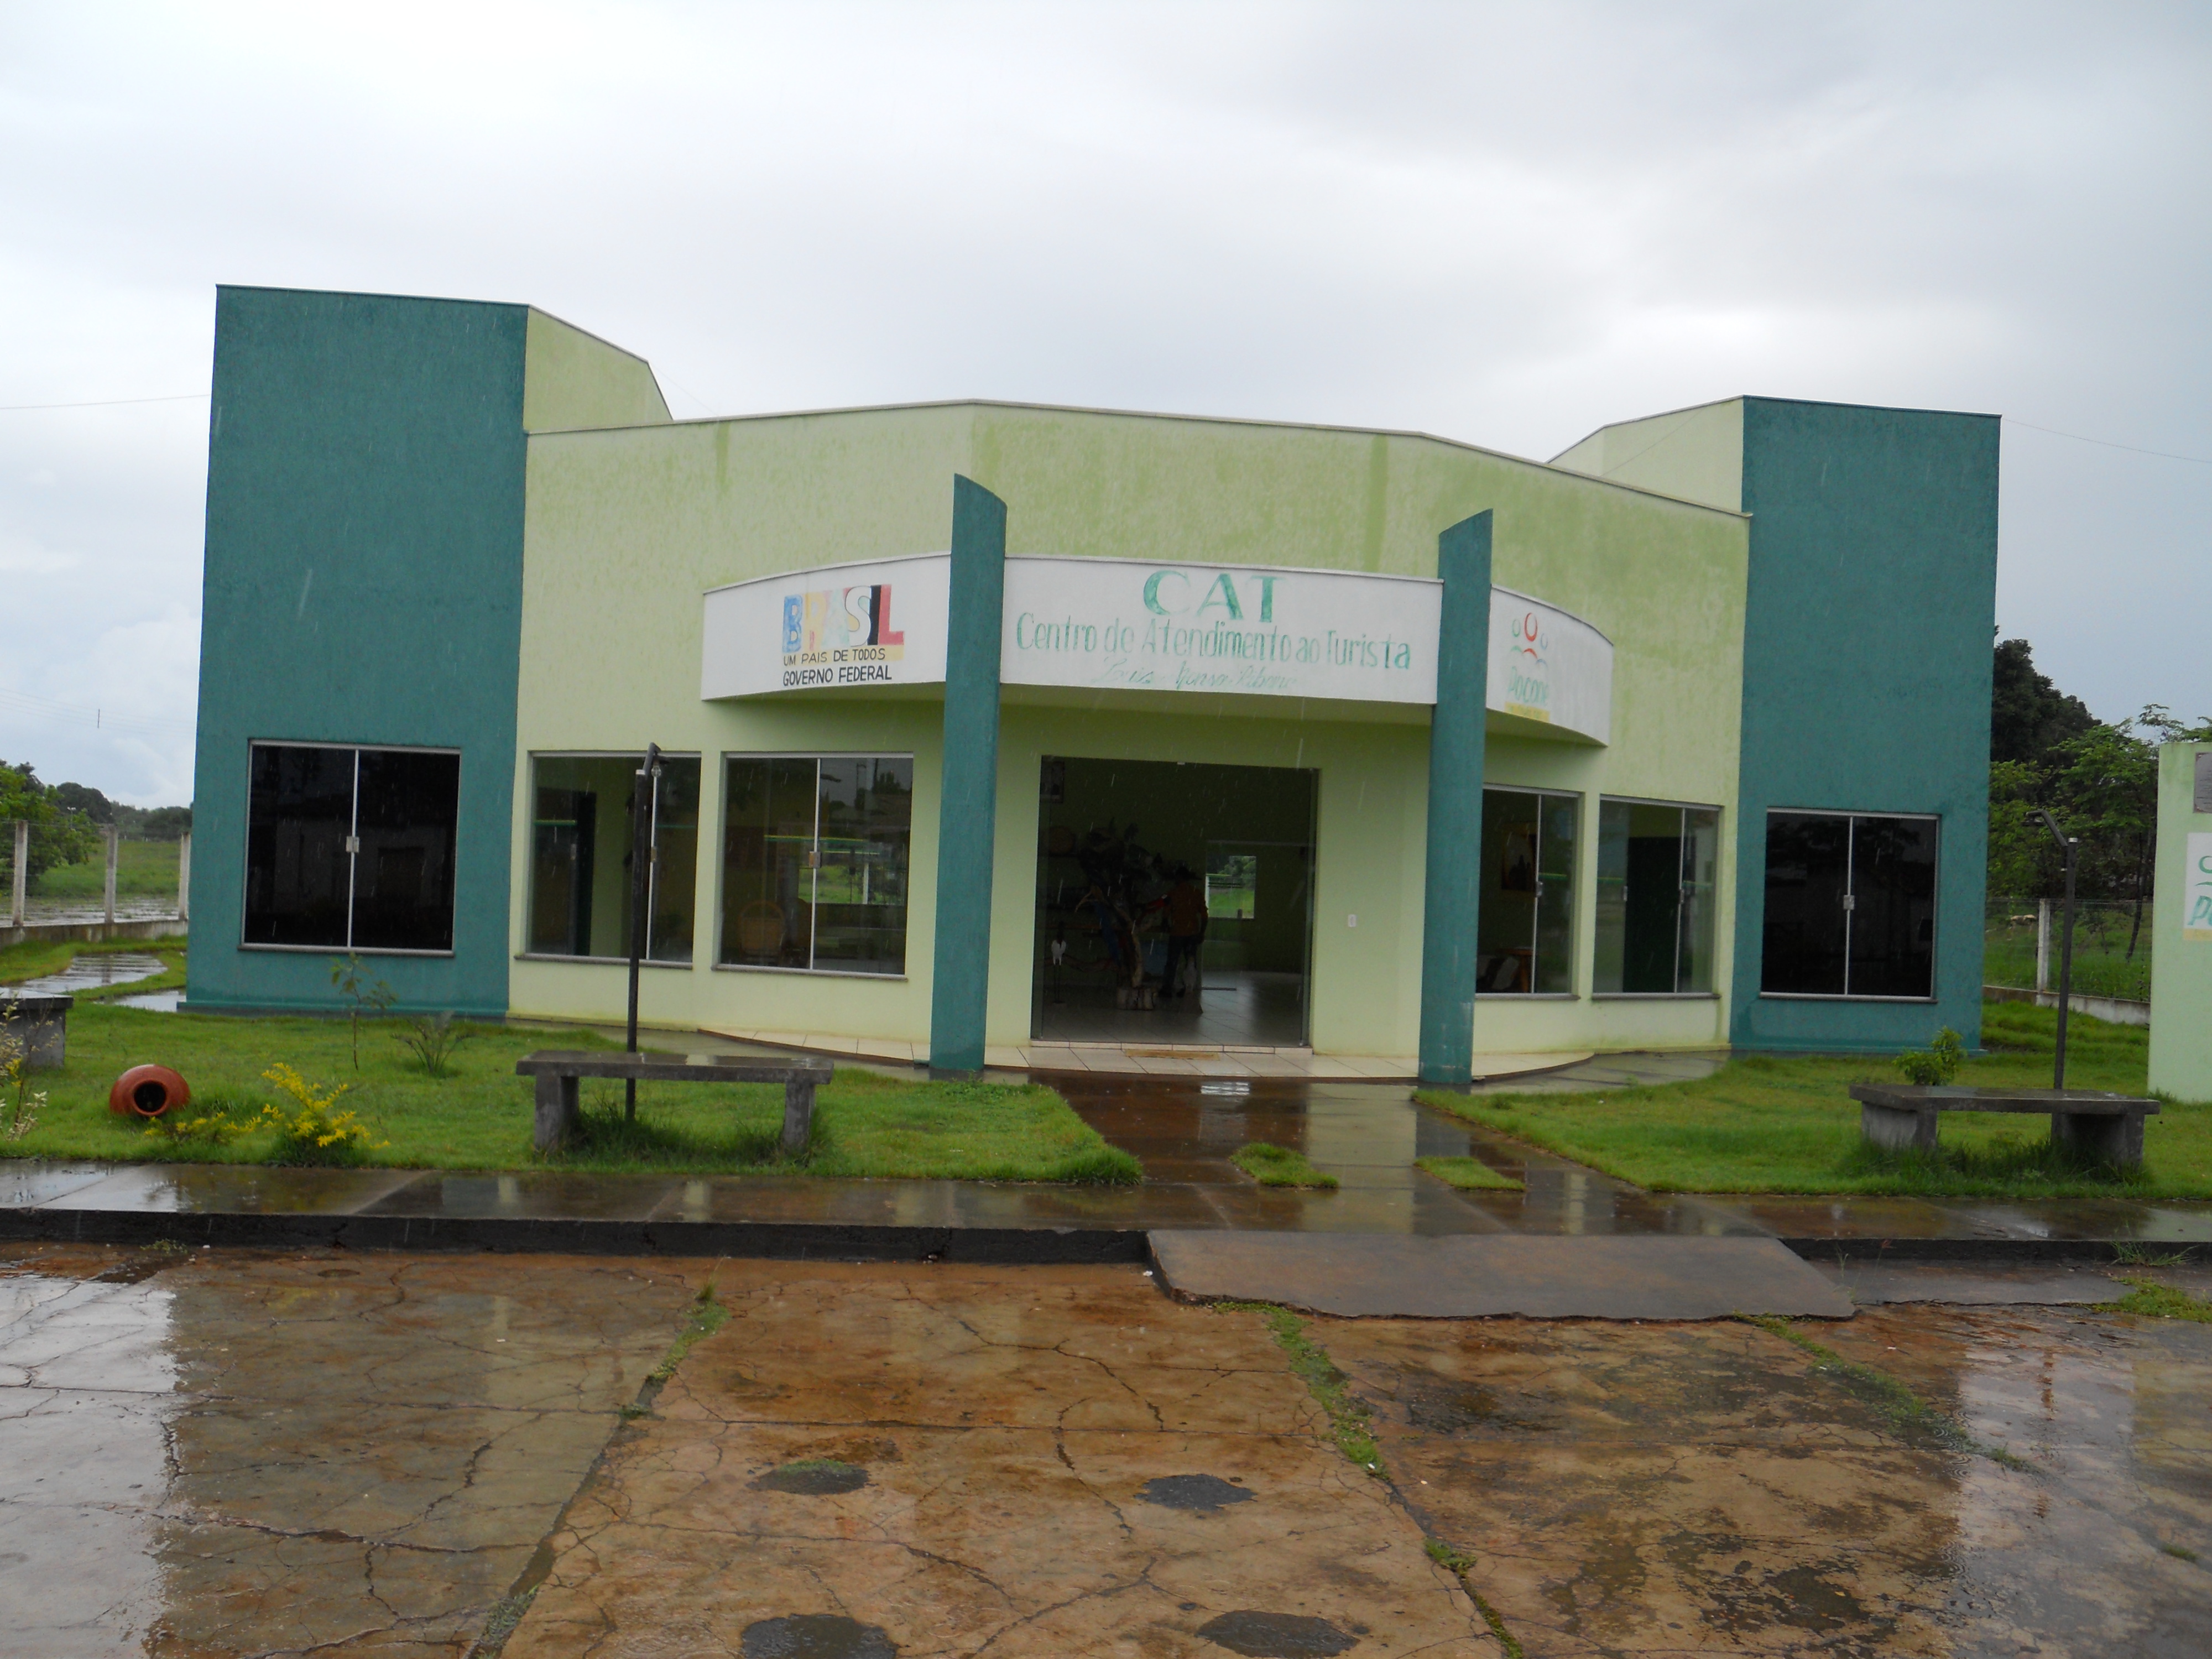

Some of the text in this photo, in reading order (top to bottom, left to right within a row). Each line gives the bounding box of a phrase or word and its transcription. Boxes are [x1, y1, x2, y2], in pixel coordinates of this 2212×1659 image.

[782, 584, 905, 653] BRASIL
[1143, 570, 1286, 623] CAT
[784, 648, 885, 666] UM PAIS DE TODOS
[1016, 612, 1411, 669] Centro de Atendimento ao Turista
[783, 665, 892, 687] GOVERNO FEDERAL
